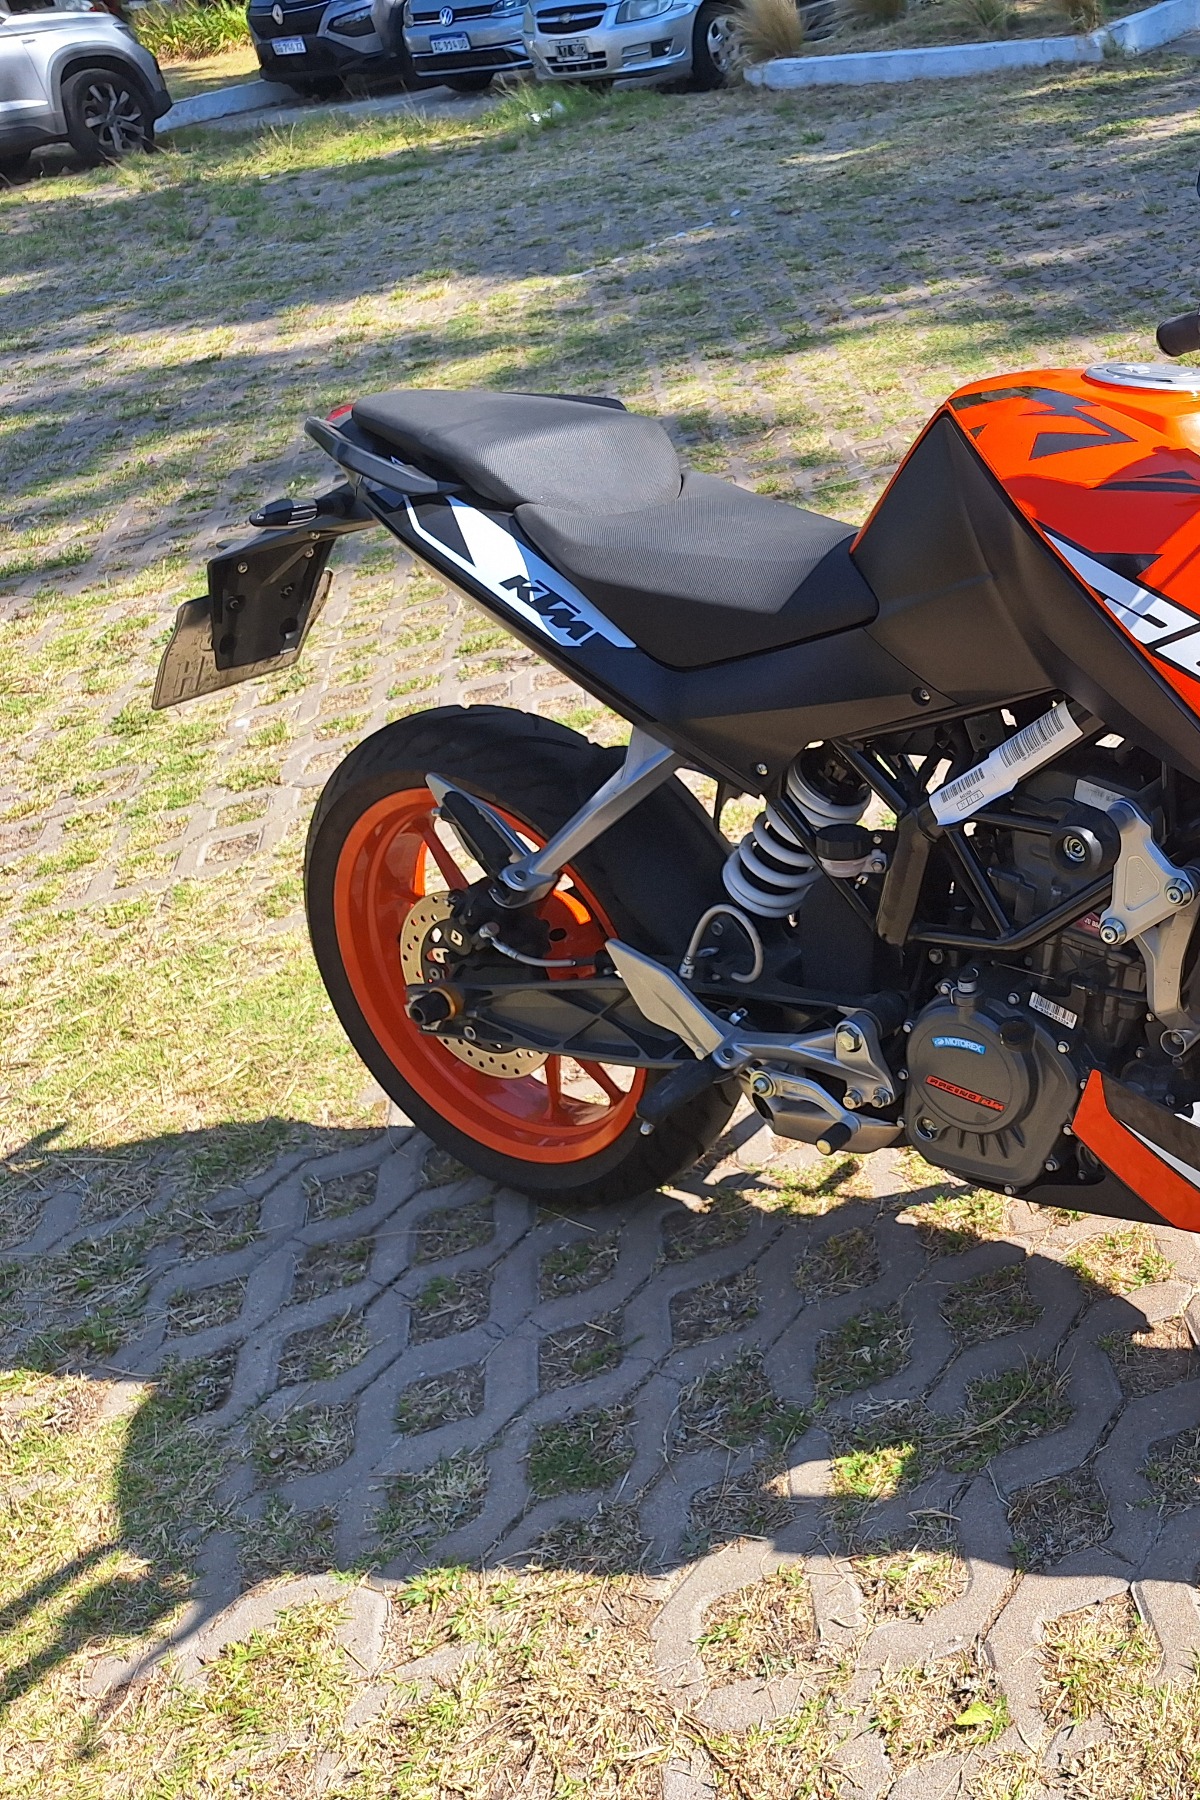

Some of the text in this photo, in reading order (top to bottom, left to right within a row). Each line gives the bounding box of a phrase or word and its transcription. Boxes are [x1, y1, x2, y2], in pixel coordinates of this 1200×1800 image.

[498, 575, 594, 641] KTM
[944, 1038, 982, 1053] MOTOREX
[930, 1078, 976, 1100] RACING
